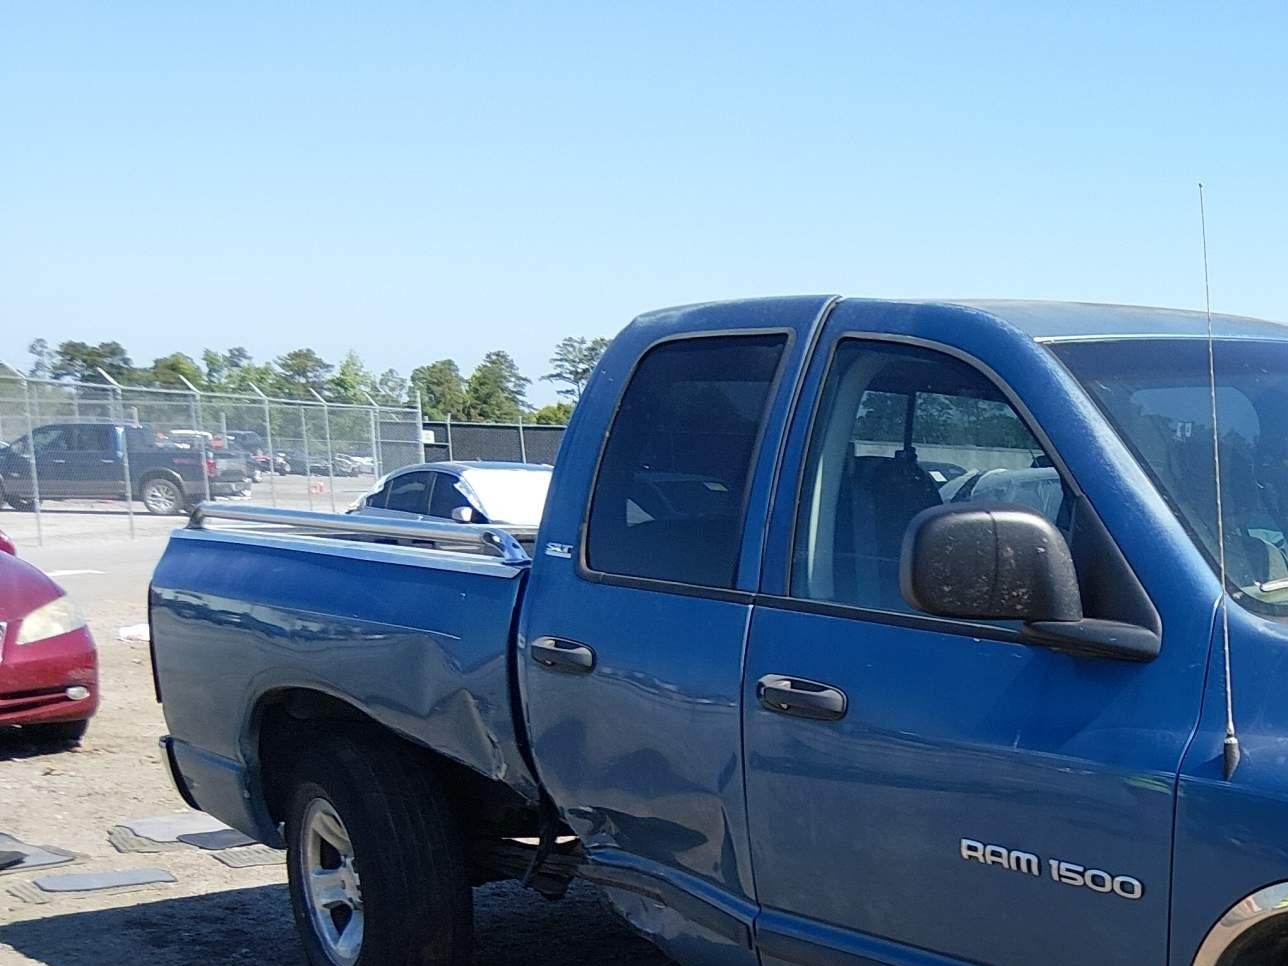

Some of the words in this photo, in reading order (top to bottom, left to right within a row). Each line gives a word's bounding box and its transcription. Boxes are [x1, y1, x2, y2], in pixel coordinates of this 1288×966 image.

[545, 542, 574, 556] SLT
[960, 838, 1041, 877] RAM
[1049, 858, 1143, 900] 1500
